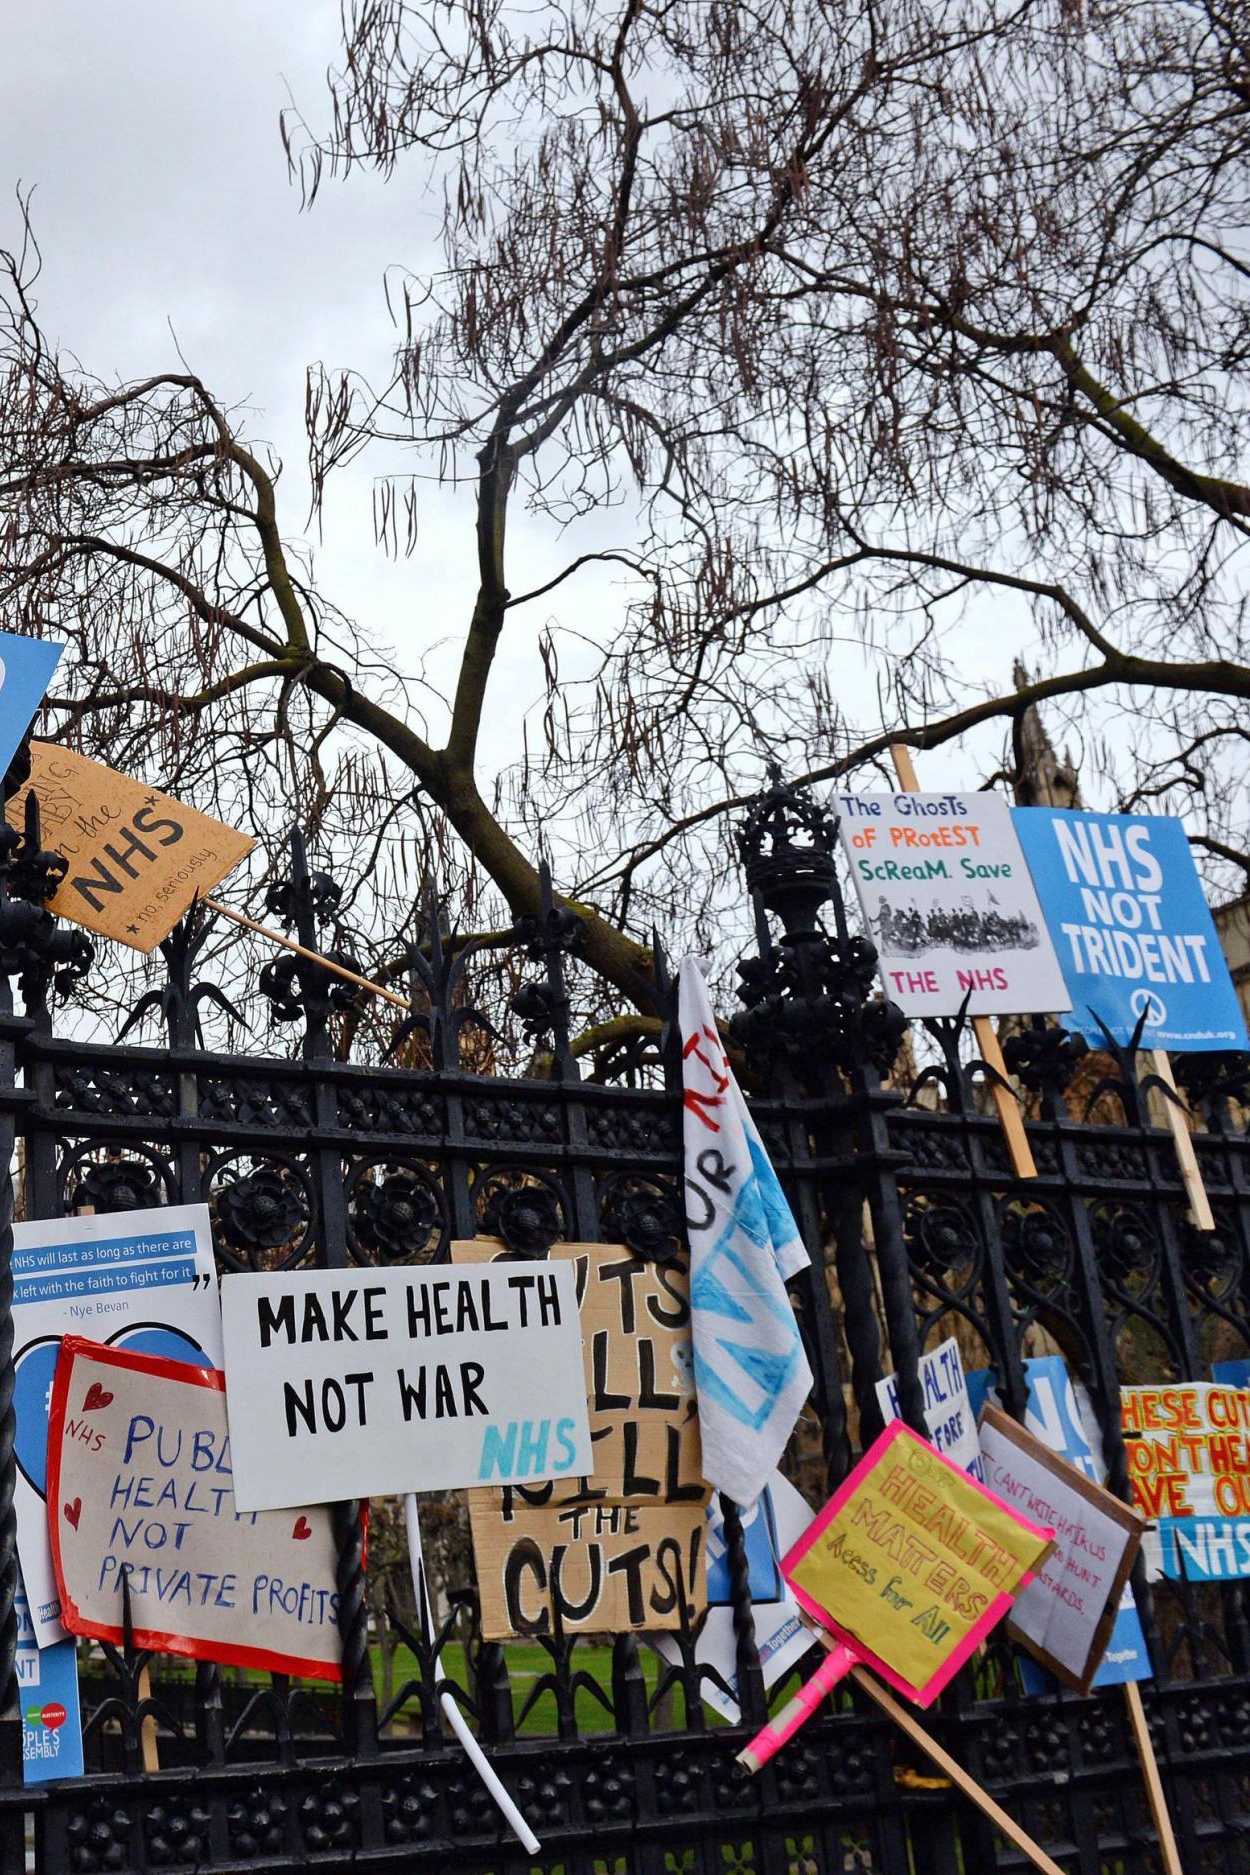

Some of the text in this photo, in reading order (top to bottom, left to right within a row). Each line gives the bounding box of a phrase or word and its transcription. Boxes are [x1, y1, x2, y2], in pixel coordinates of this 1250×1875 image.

[73, 802, 122, 839] the
[840, 796, 882, 817] The
[155, 847, 221, 903] seriously
[1052, 818, 1163, 893] NHS
[1080, 887, 1163, 932] NOT
[1061, 923, 1212, 984] TRIDENT
[889, 967, 1009, 994] THE NHS
[14, 1255, 36, 1269] NHS
[37, 1252, 55, 1266] will
[58, 1251, 79, 1264] last
[81, 1250, 94, 1261] as
[96, 1247, 121, 1260] long
[122, 1246, 135, 1256] as
[136, 1242, 170, 1255] there
[172, 1239, 192, 1250] are
[20, 1284, 38, 1298] left
[39, 1282, 63, 1296] with
[64, 1279, 85, 1293] the
[87, 1276, 115, 1290] faith
[116, 1275, 128, 1286] to
[130, 1271, 159, 1286] fight
[161, 1268, 180, 1280] for
[70, 1301, 130, 1319] Nye Bevan
[257, 1274, 562, 1348] MAKE HEALTH
[283, 1361, 490, 1437] NOT WAR
[65, 1419, 107, 1451] NHS
[478, 1417, 577, 1482] NHS
[110, 1475, 258, 1526] HEALT
[558, 1505, 641, 1541] THE
[879, 1463, 1019, 1589] HEALTH
[108, 1517, 194, 1551] NOT
[850, 1497, 989, 1622] MATTERS
[98, 1555, 343, 1626] PRIVATE PROFITS
[504, 1524, 703, 1635] CUTS!
[880, 1576, 914, 1612] for
[910, 1604, 952, 1646] All
